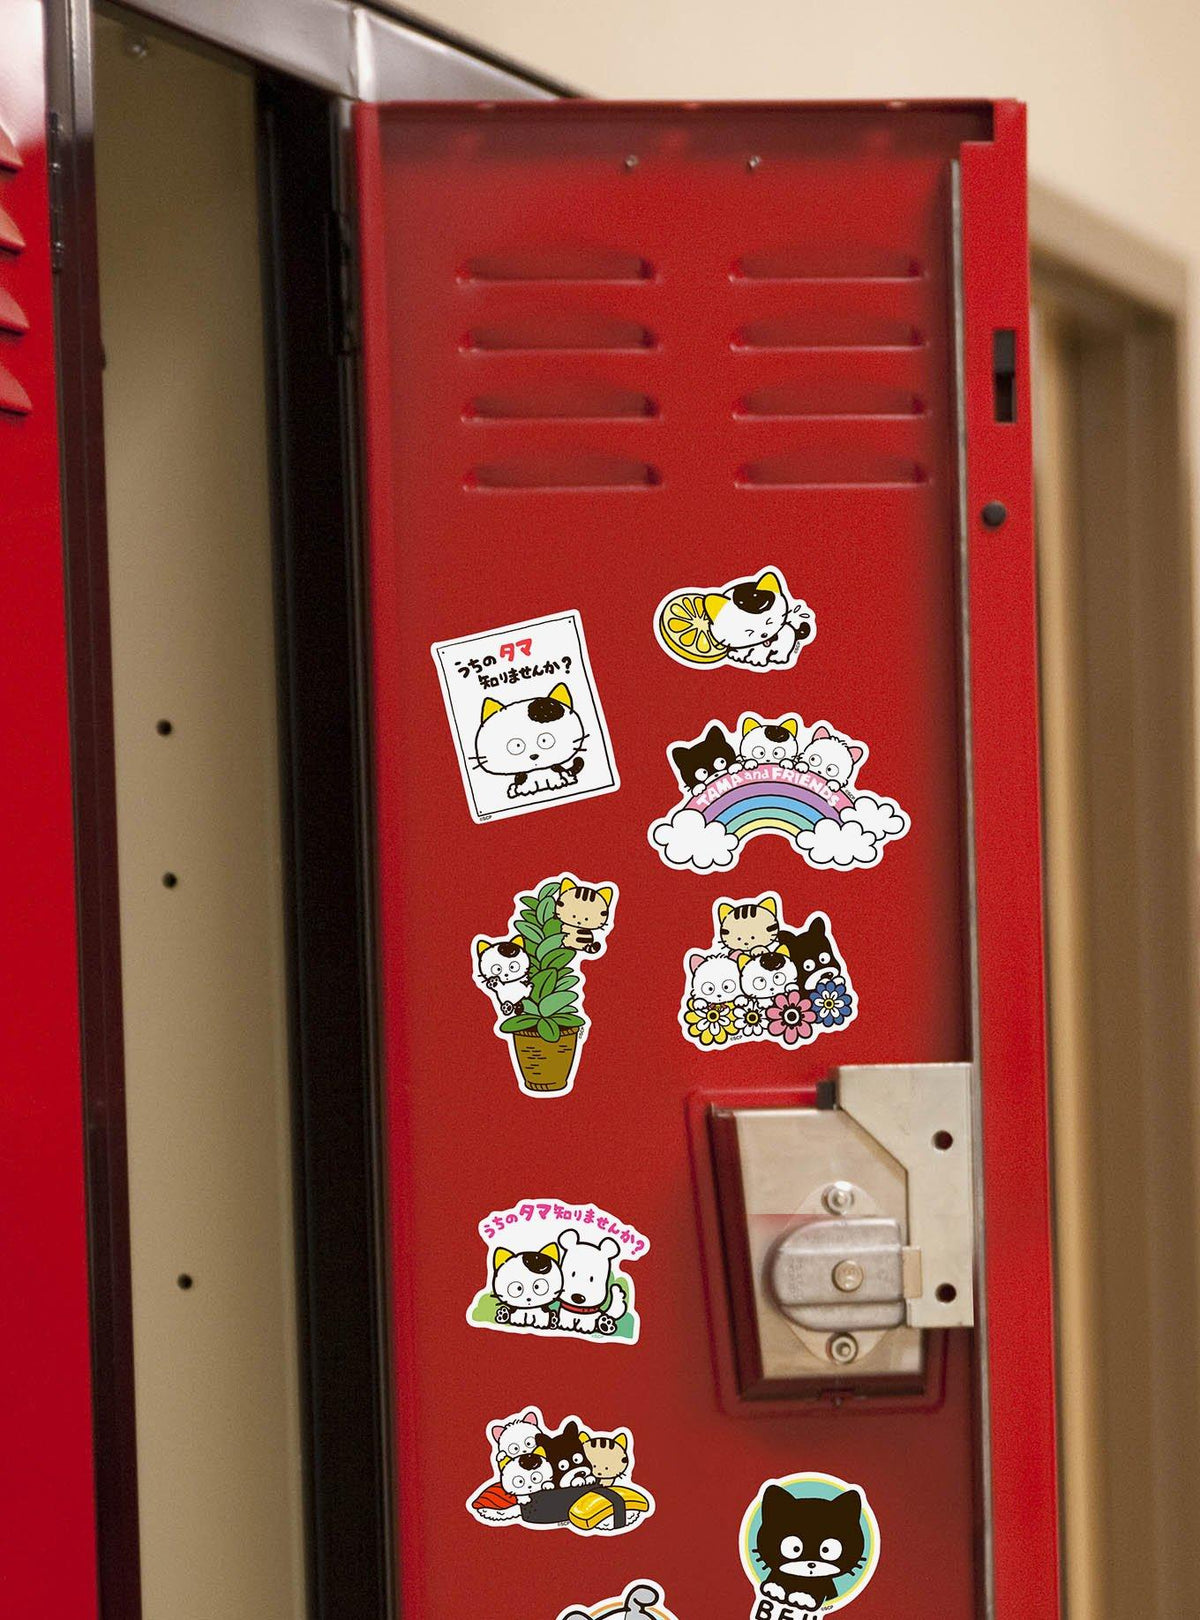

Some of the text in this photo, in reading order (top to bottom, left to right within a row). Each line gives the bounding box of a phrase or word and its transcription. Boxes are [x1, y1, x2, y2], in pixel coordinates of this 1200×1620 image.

[696, 767, 840, 807] TAMA and FRIENDS
